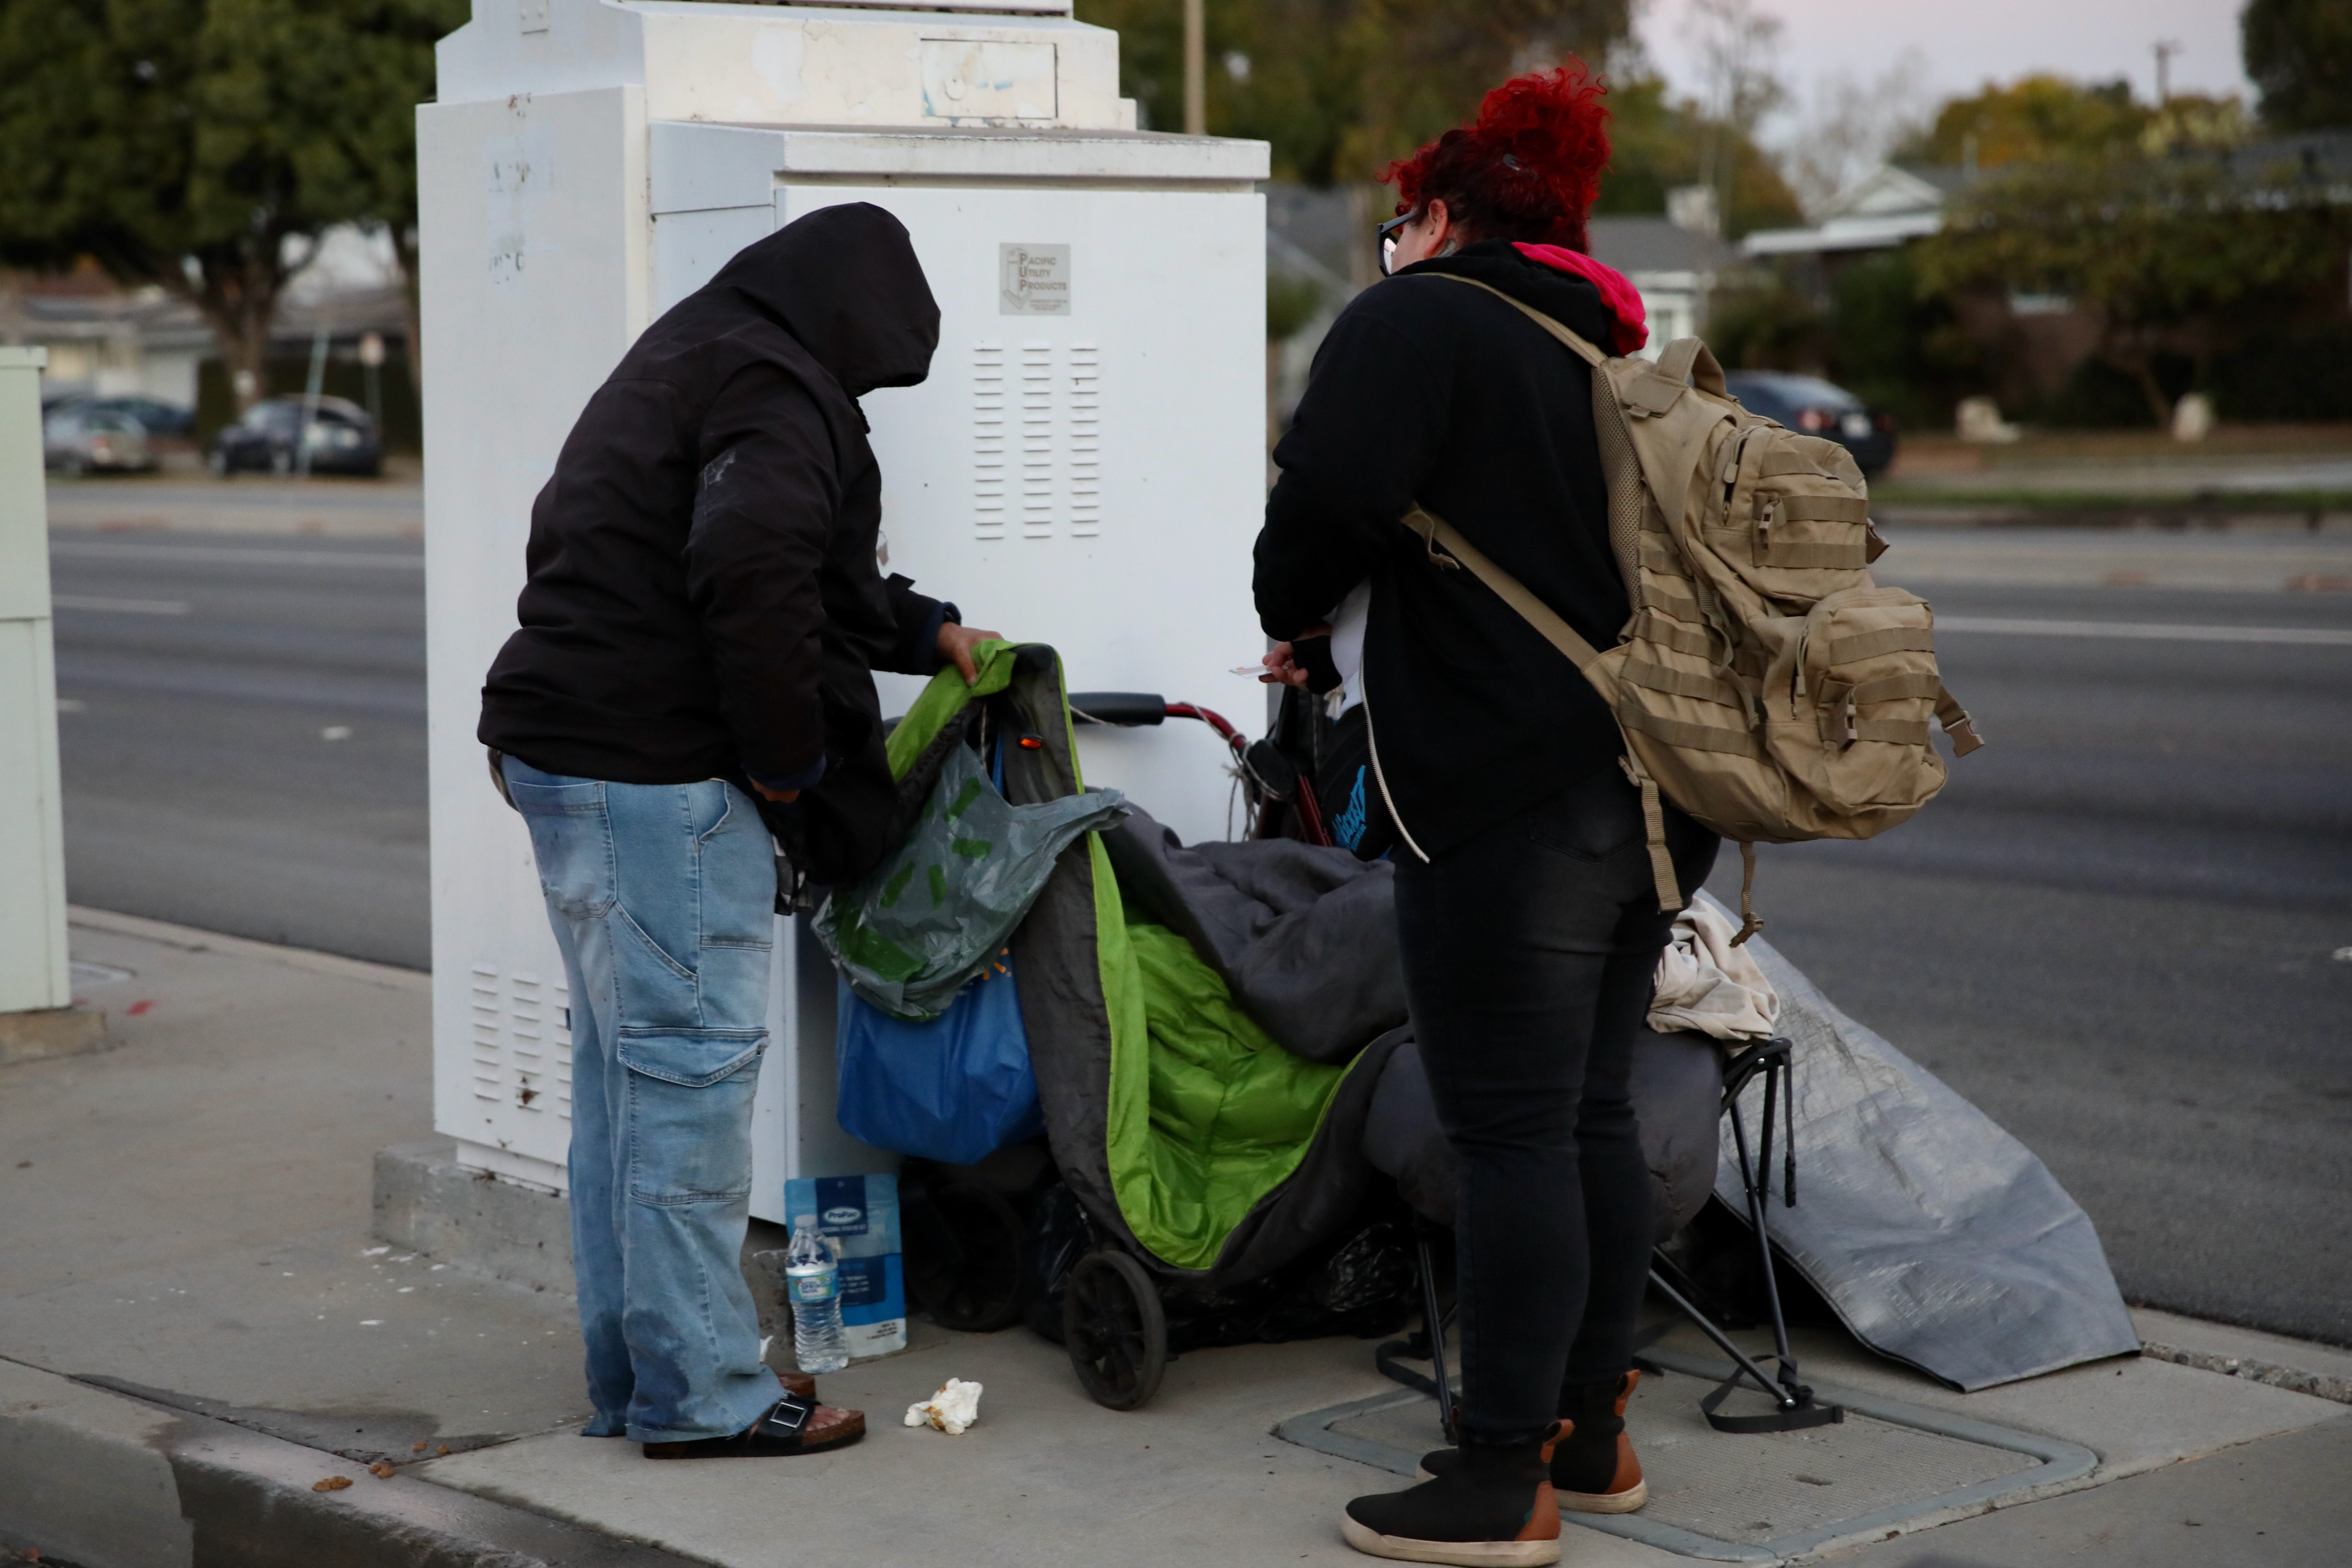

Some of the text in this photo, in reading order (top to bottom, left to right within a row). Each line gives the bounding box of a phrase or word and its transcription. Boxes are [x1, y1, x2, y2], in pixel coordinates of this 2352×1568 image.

[1020, 253, 1056, 265] PACIFIC
[1020, 267, 1051, 277] UTILITY
[1020, 279, 1067, 291] PRODUCTS
